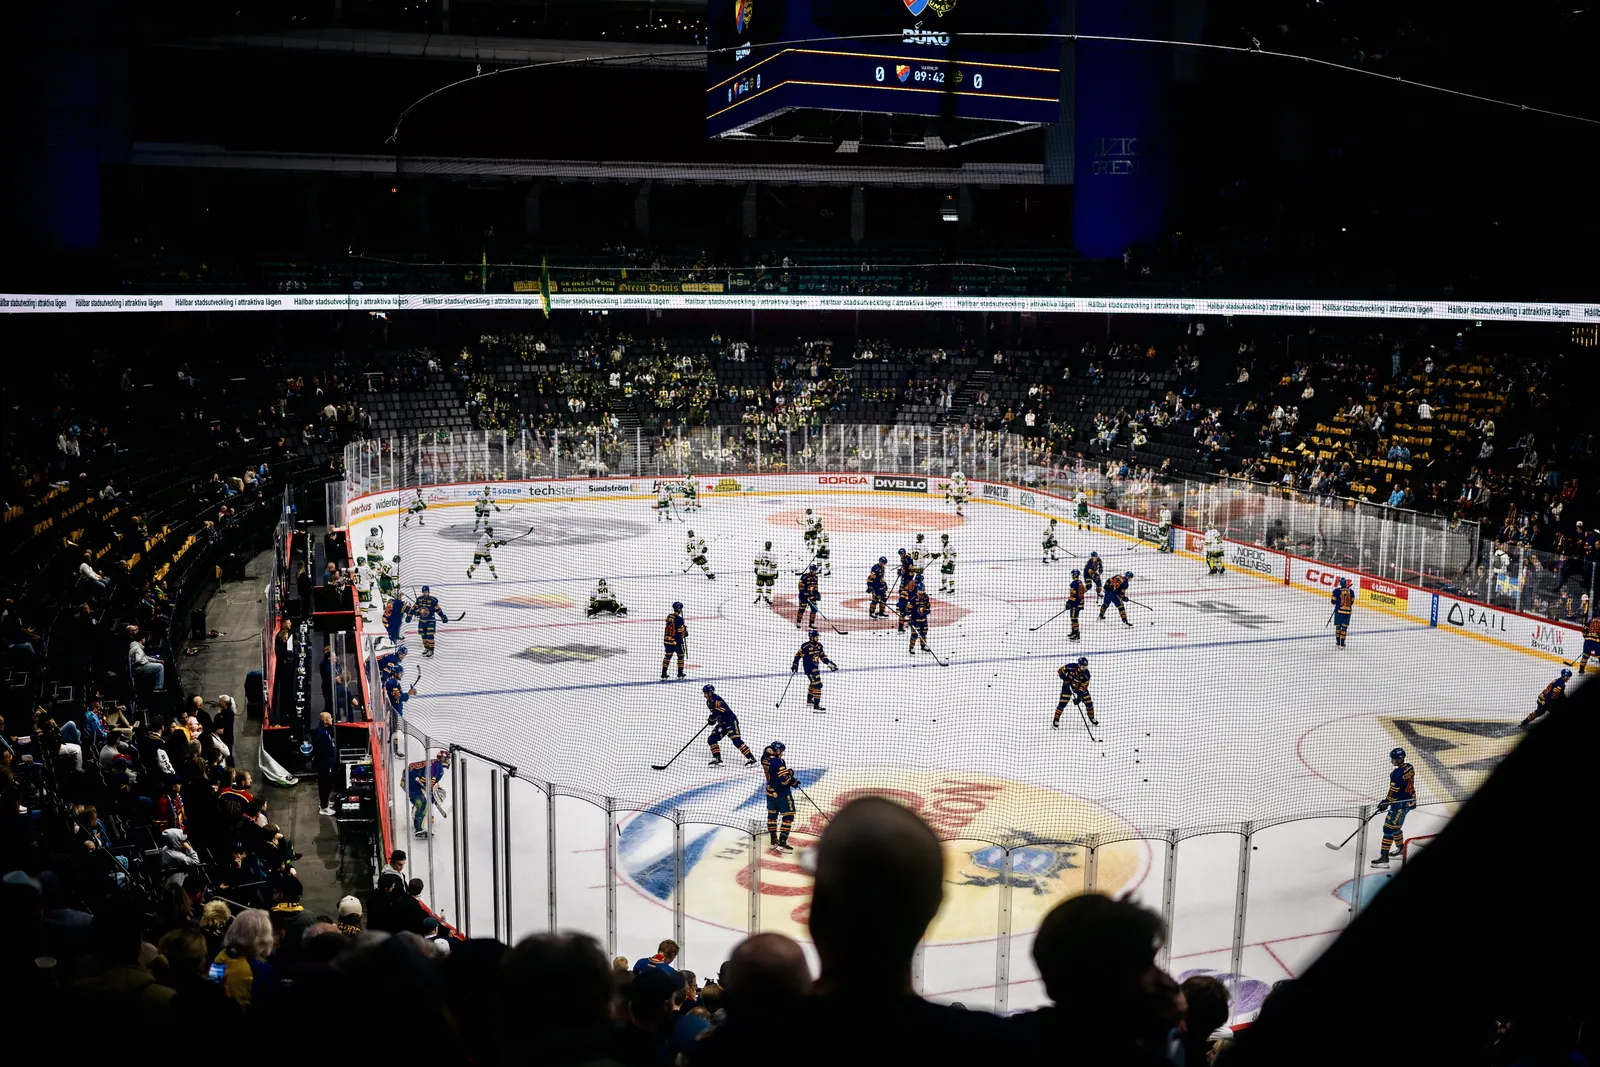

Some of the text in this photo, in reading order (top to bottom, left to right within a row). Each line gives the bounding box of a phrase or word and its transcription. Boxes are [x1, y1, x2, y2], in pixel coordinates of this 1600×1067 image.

[876, 66, 982, 88] 0 09:42 0
[619, 284, 646, 292] Green
[649, 284, 679, 292] Devils
[529, 485, 576, 495] techster
[876, 479, 926, 490] DIVELLO
[1237, 546, 1265, 562] NORDIC
[760, 560, 770, 568] 47
[1231, 554, 1272, 574] WELLNESS
[1468, 608, 1506, 631] RAIL
